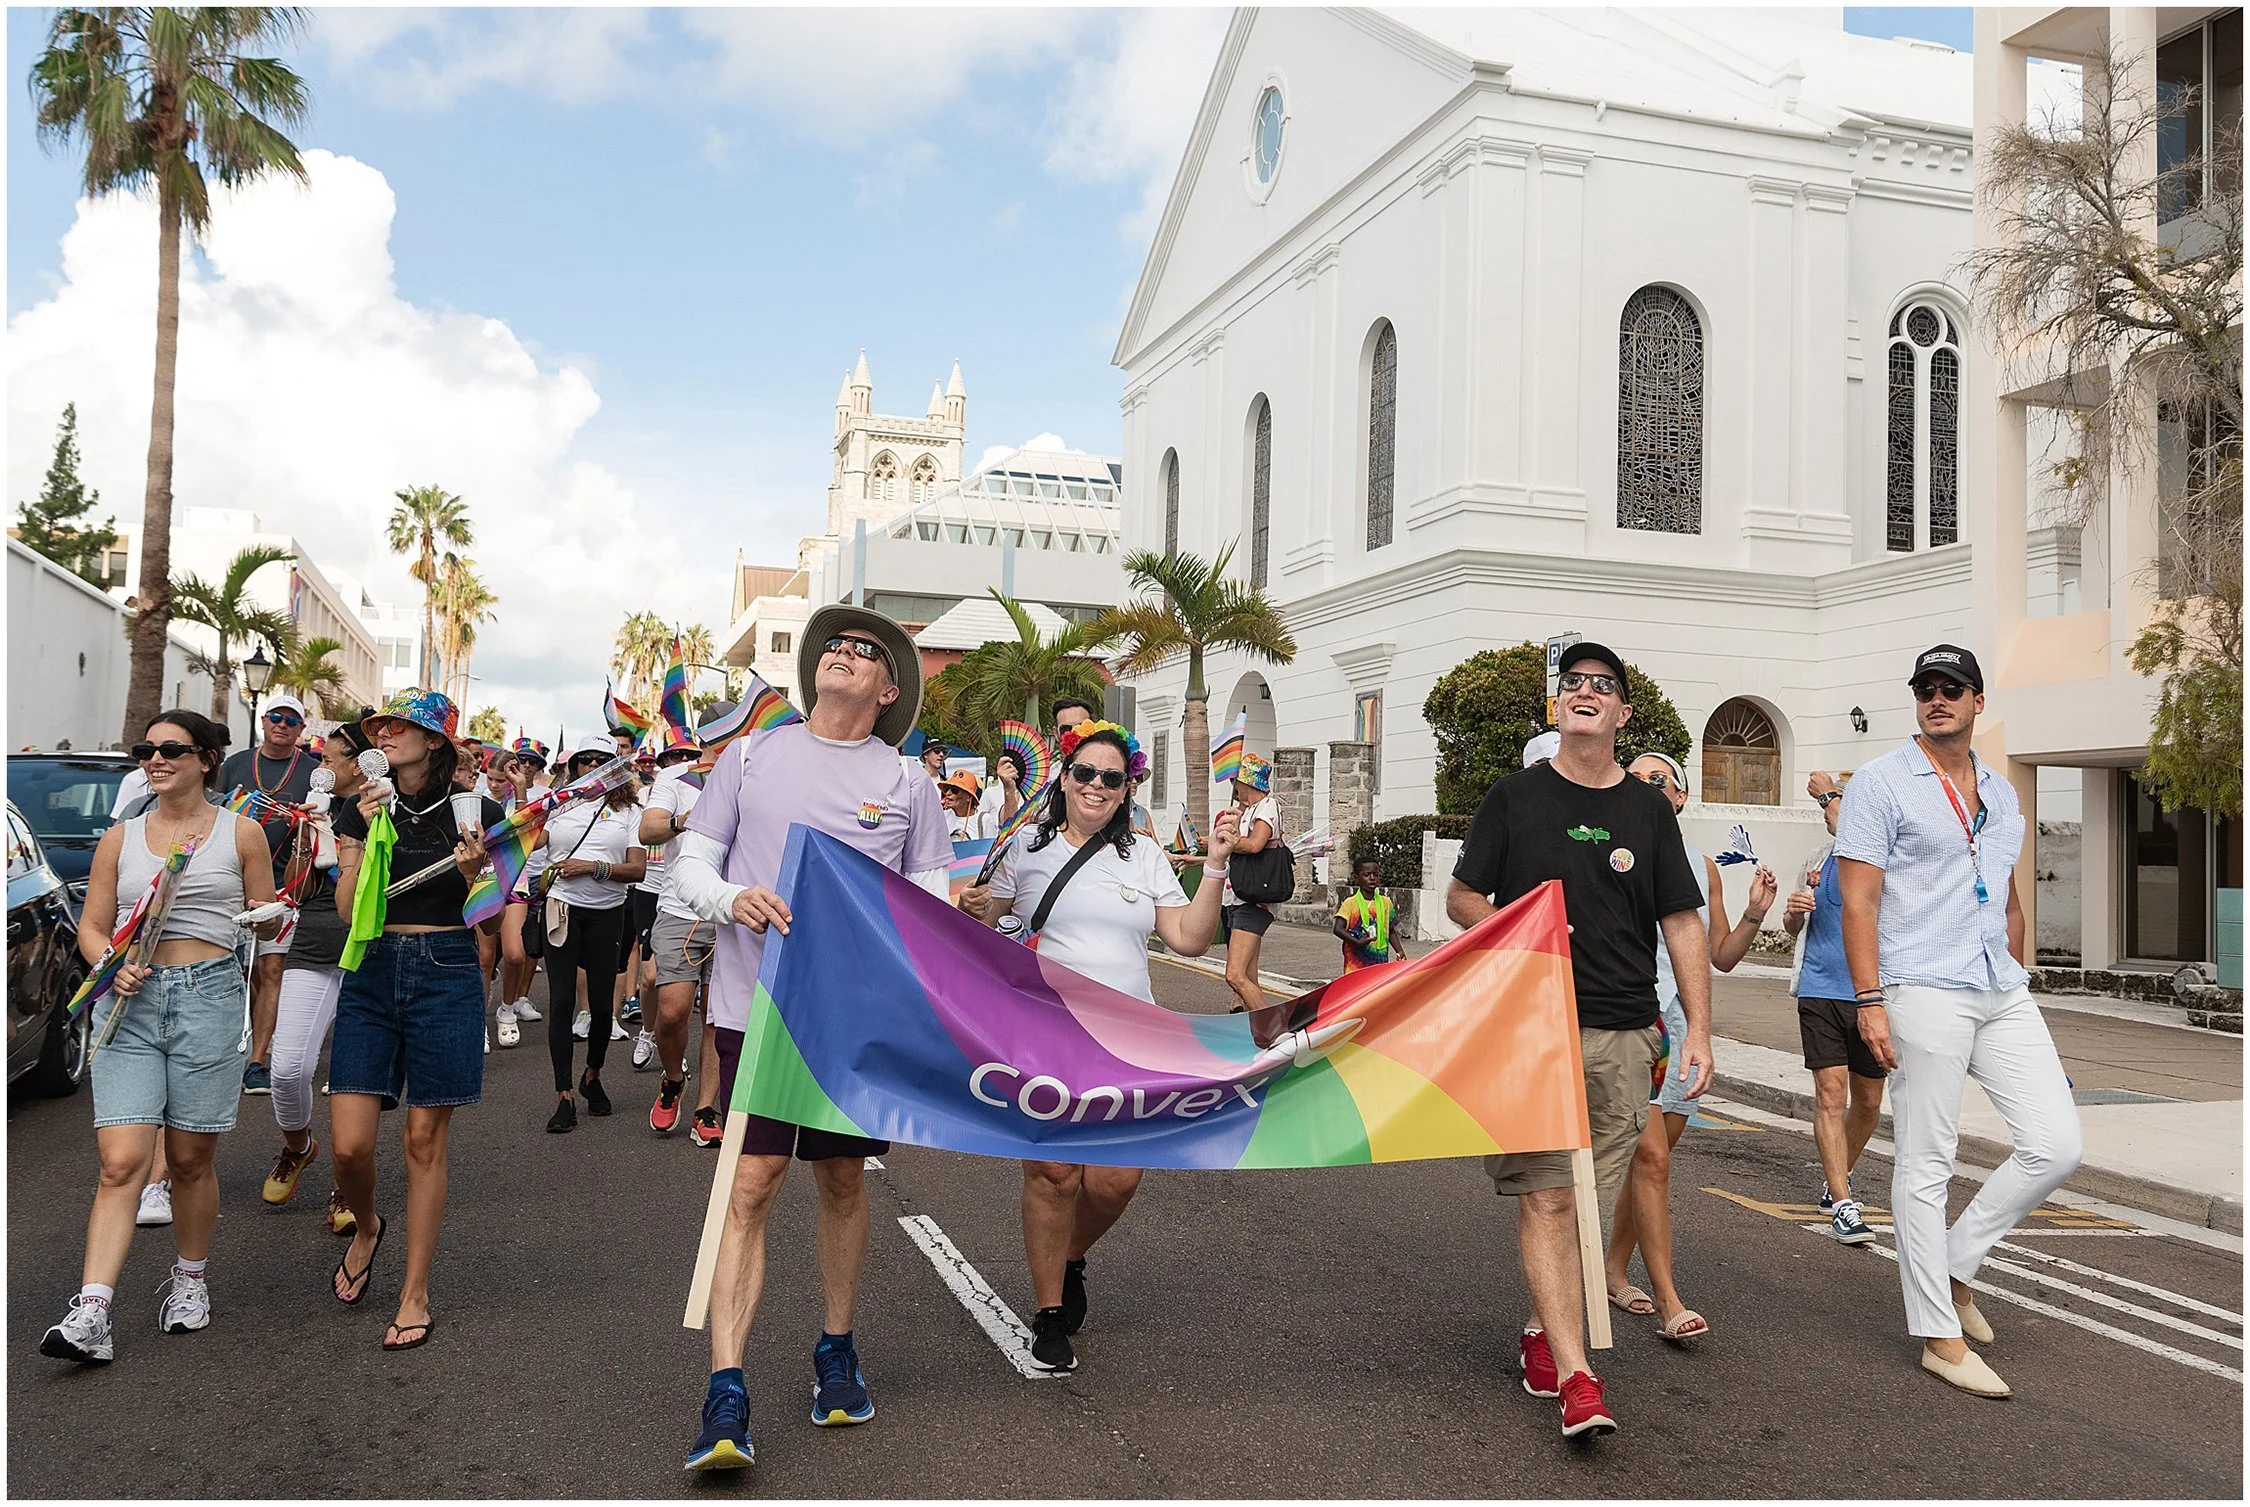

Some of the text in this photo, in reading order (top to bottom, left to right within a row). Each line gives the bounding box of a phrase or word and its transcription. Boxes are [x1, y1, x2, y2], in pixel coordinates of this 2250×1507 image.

[1551, 646, 1558, 664] P
[859, 810, 881, 824] ALLY
[1611, 858, 1631, 871] WINS
[969, 1062, 1269, 1122] convex
